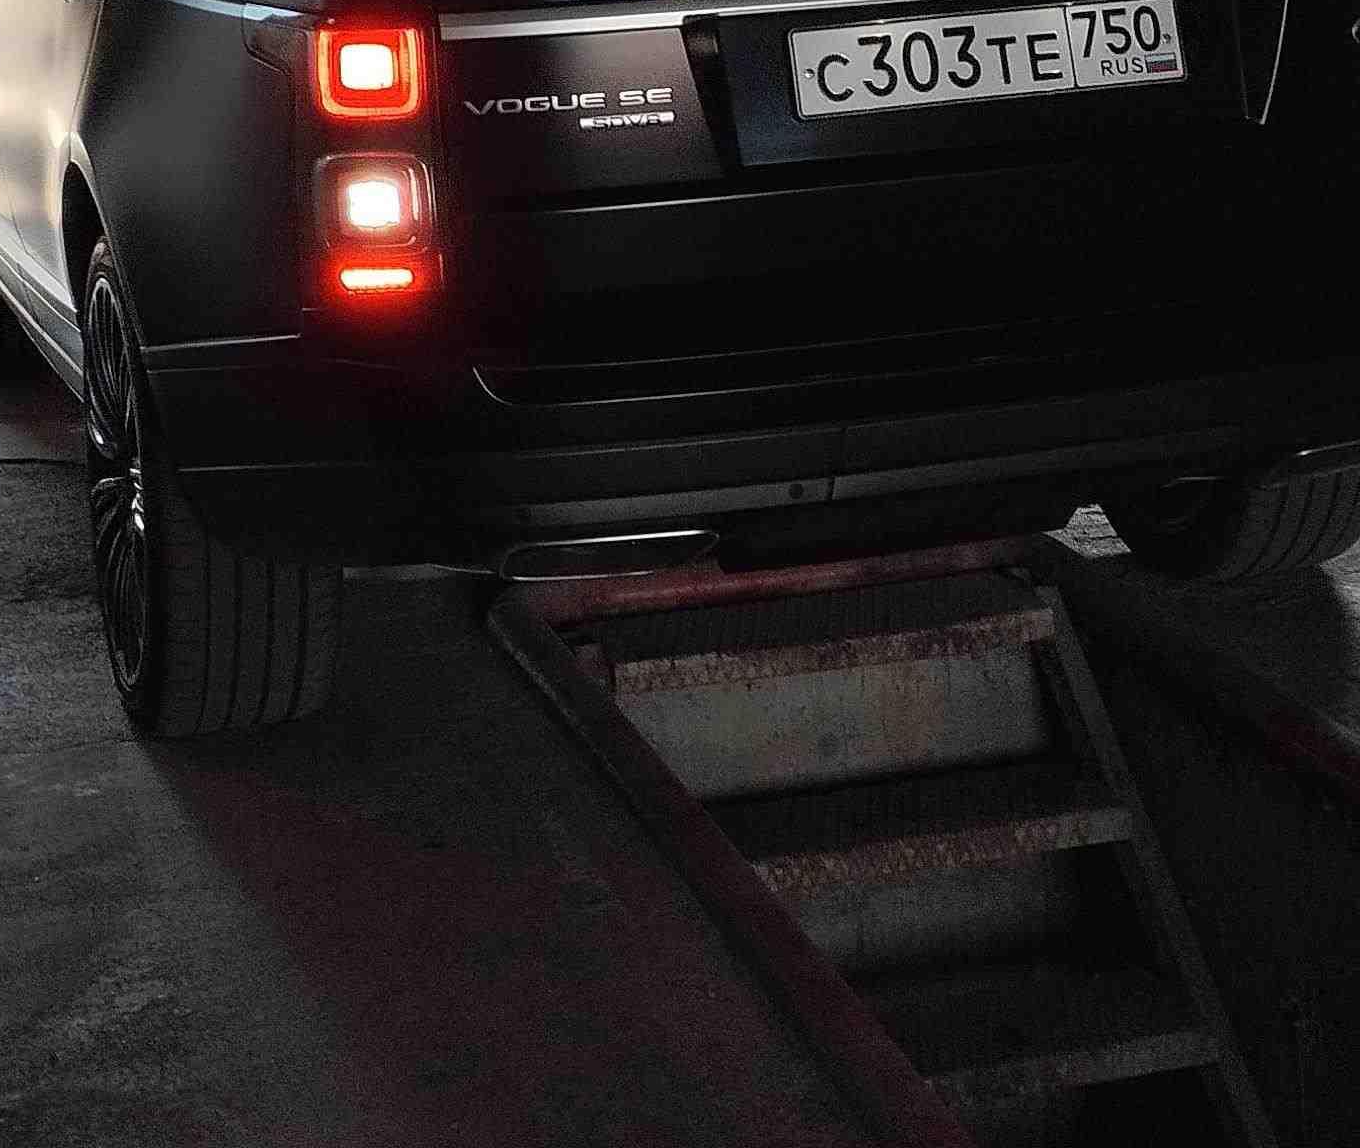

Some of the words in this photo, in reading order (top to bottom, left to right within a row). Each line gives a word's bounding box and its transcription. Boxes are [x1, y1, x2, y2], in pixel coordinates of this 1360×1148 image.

[1071, 5, 1162, 59] 750
[1100, 58, 1144, 78] RUS
[463, 92, 606, 115] VOGUE
[619, 87, 673, 106] SE
